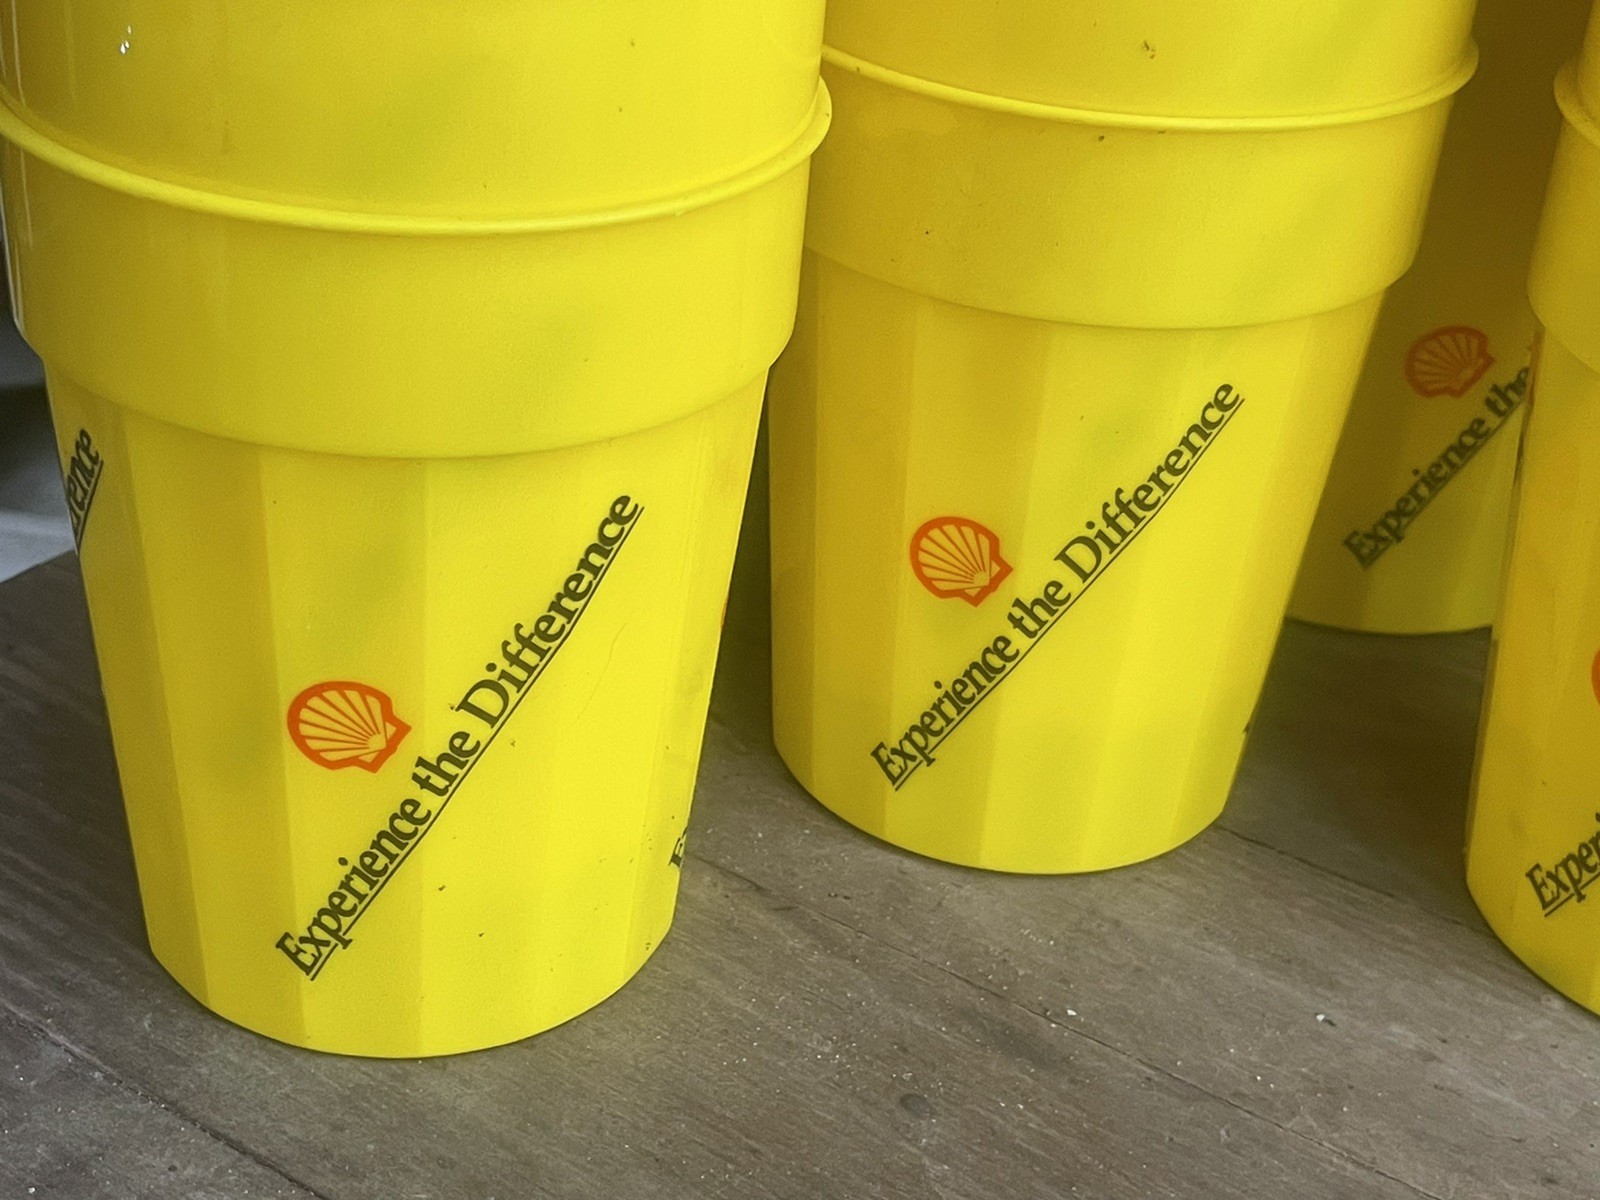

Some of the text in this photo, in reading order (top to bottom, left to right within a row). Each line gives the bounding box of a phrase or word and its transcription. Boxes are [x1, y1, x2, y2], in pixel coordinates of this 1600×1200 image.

[870, 383, 1240, 786] Experience the Difference
[1344, 417, 1491, 566] Experience
[275, 495, 639, 976] Experience the Difference
[1525, 812, 1600, 910] Exper
